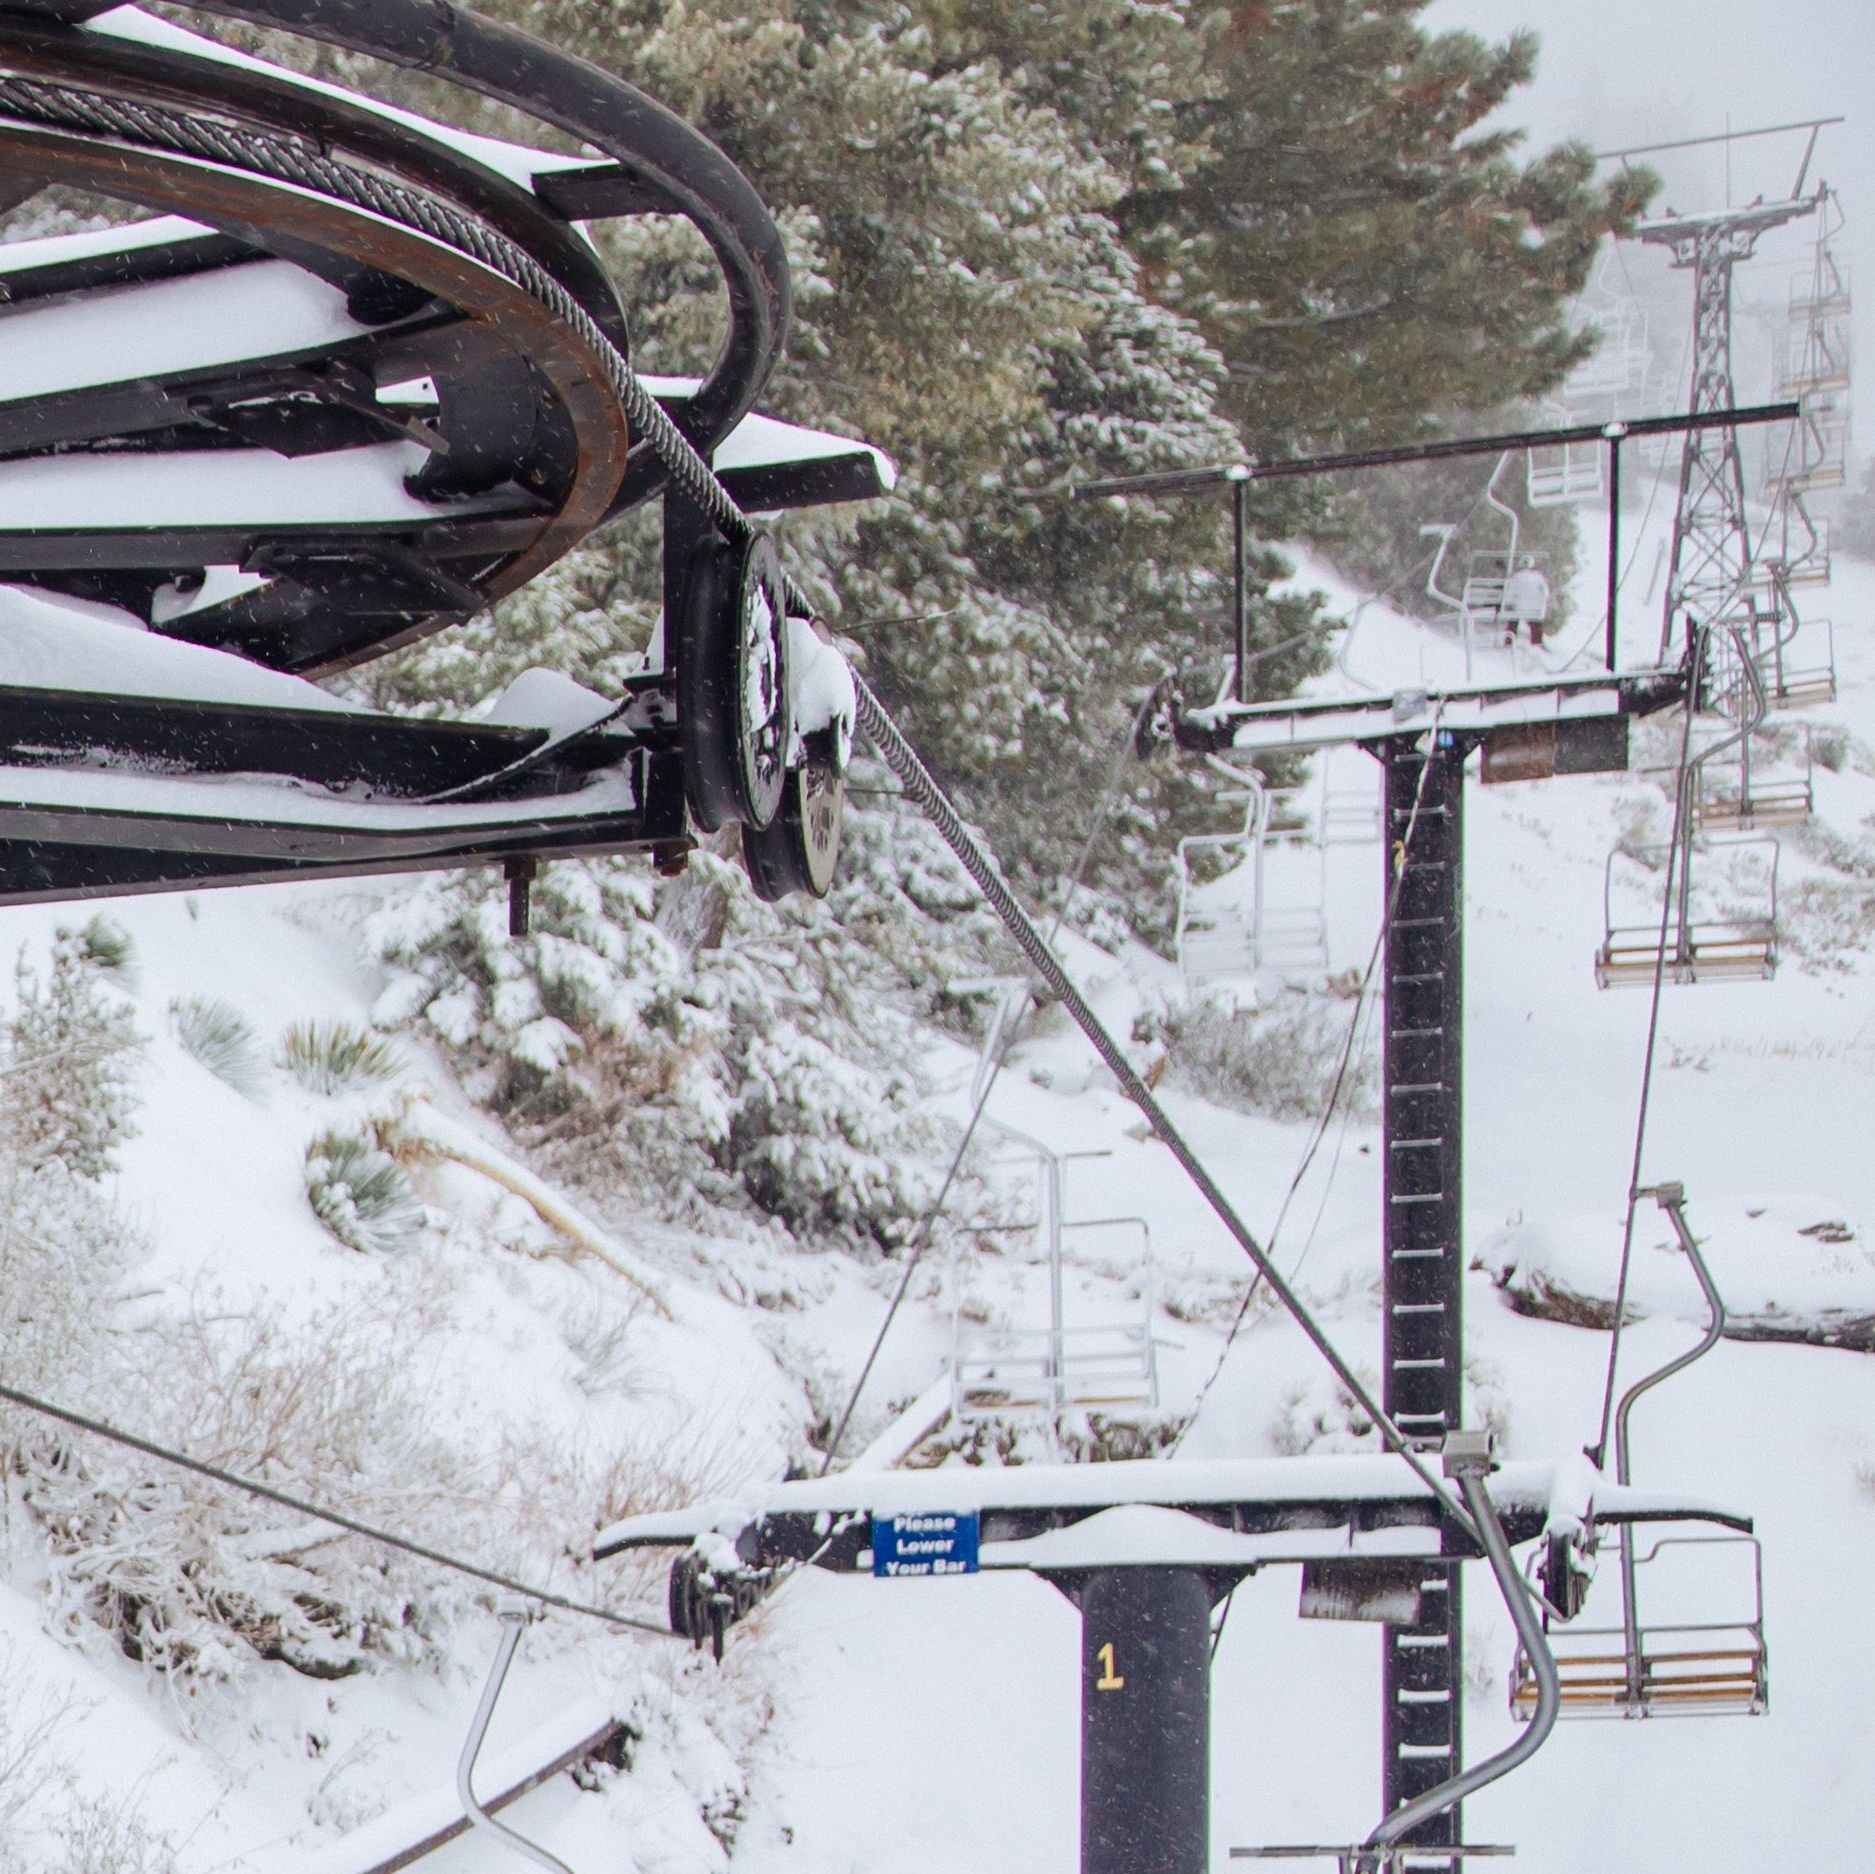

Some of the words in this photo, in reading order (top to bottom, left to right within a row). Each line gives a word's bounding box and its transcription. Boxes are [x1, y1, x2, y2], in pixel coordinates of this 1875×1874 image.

[893, 1516, 956, 1532] Please
[896, 1538, 954, 1556] Lower
[886, 1561, 930, 1577] Your
[932, 1558, 967, 1575] Bar
[1096, 1642, 1124, 1691] 1
